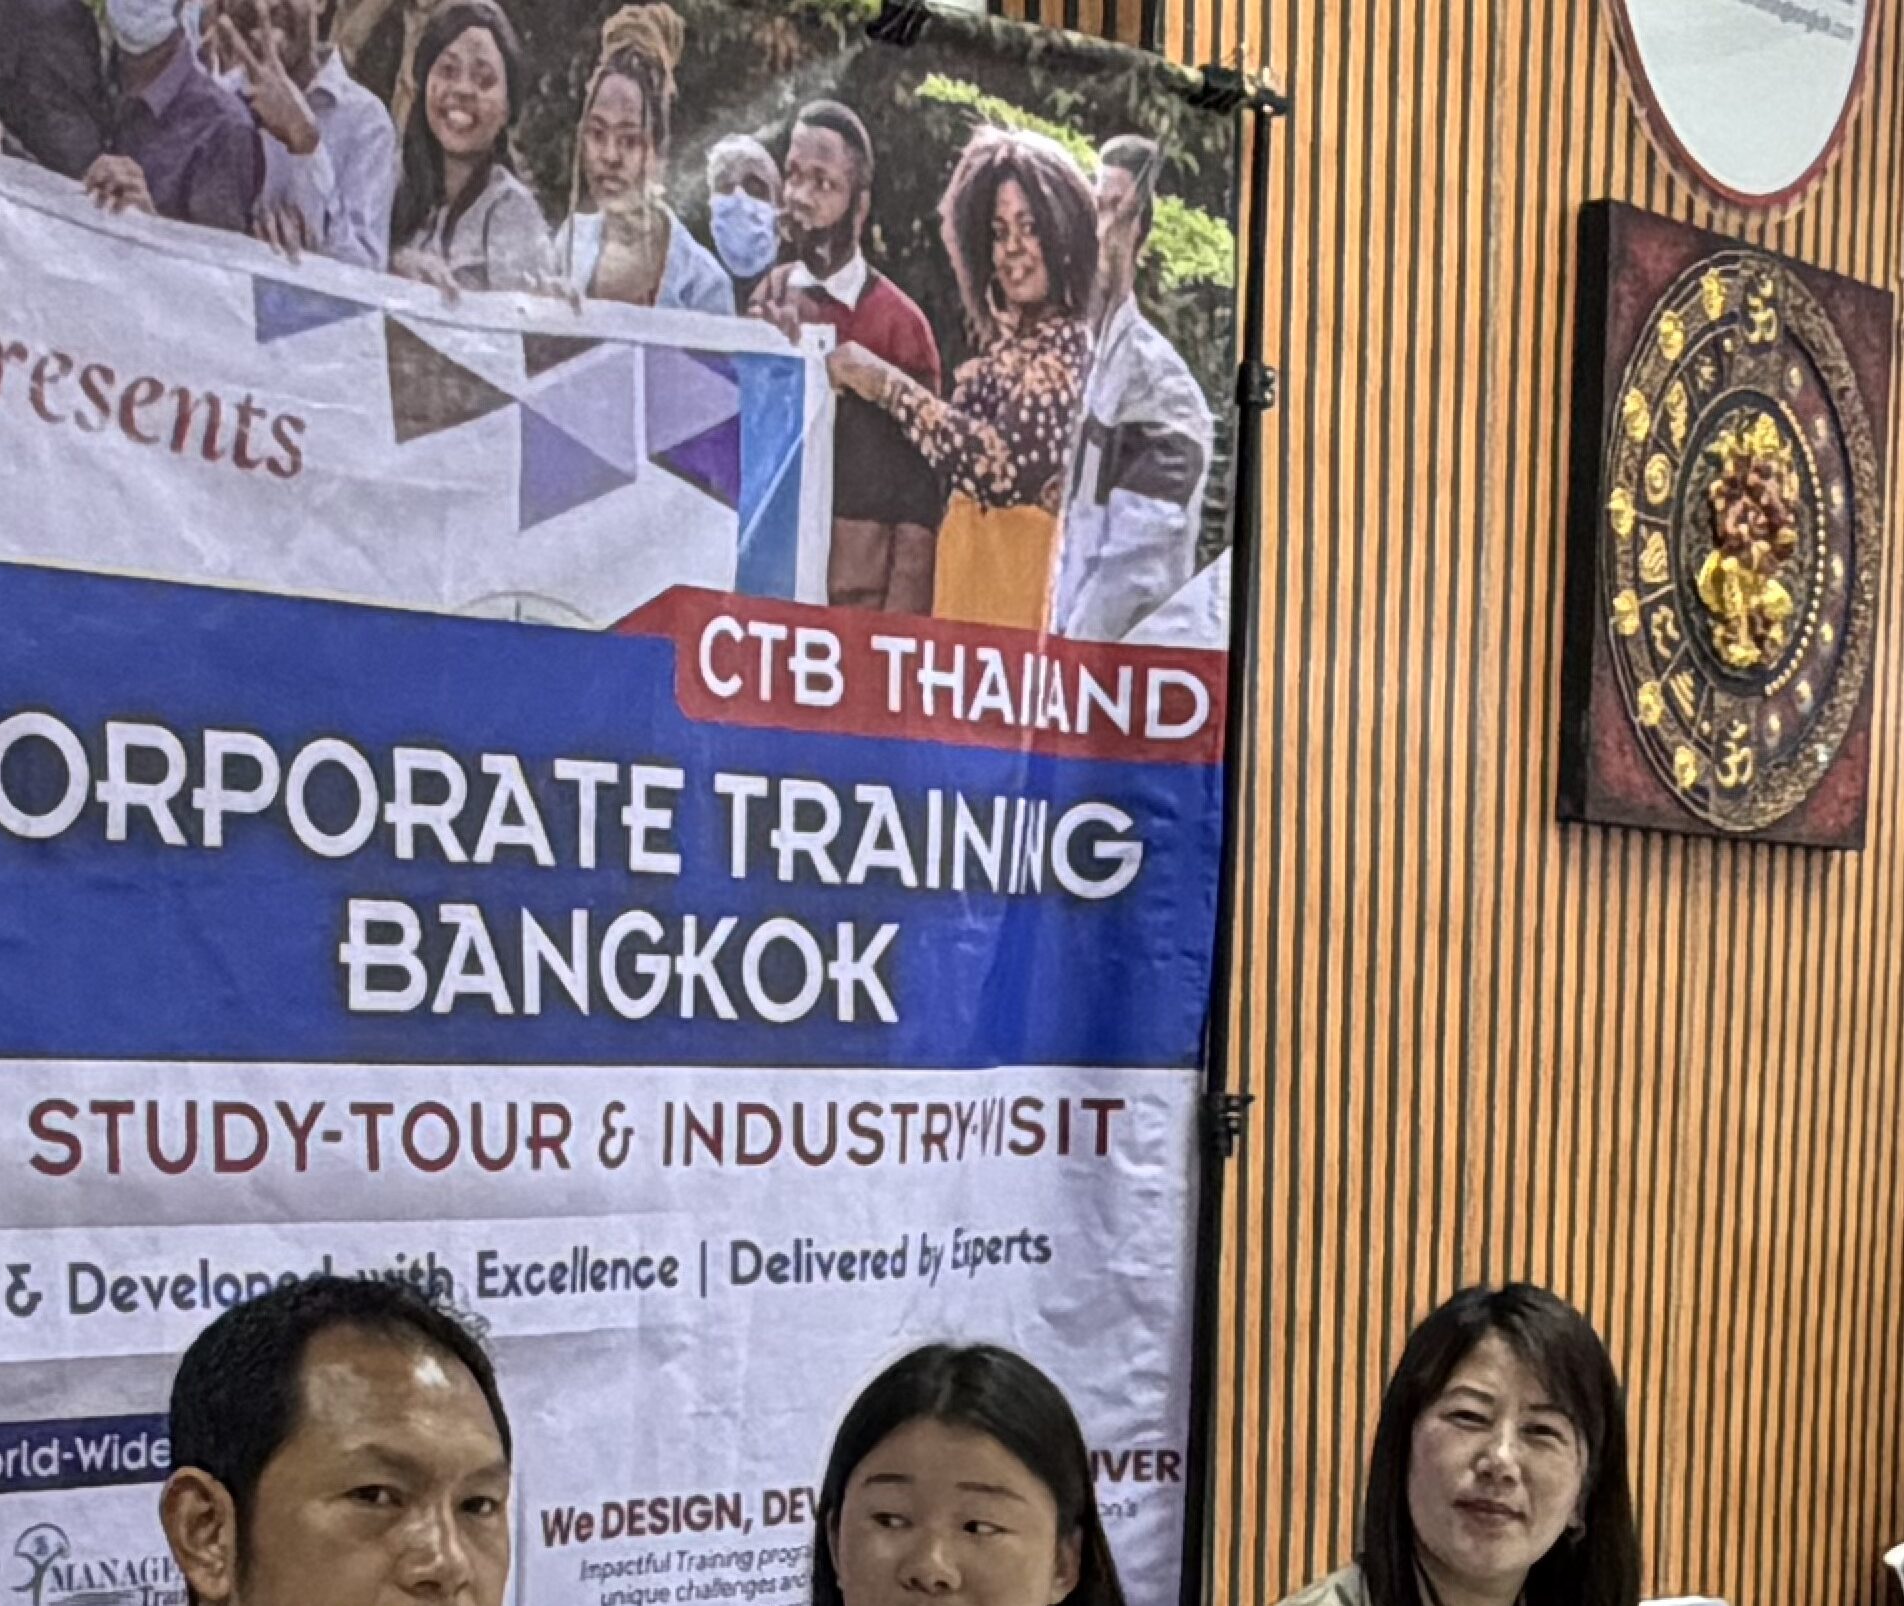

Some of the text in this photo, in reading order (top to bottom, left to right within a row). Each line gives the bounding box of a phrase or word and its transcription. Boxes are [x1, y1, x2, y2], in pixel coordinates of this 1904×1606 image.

[698, 614, 1210, 739] CTB THAILAND
[713, 772, 1144, 900] TRAINING
[337, 897, 898, 1024] BANGKOK
[28, 1097, 572, 1176] STUDY-TOUR
[597, 1100, 633, 1168] &
[4, 1264, 43, 1315] &
[476, 1243, 679, 1301] Excellence
[729, 1232, 909, 1289] Delivered
[918, 1233, 945, 1288] by
[950, 1227, 1052, 1279] Experts
[1090, 1450, 1182, 1484] IVER
[541, 1487, 818, 1549] We DESIGN, DEV
[47, 1555, 182, 1594] MANAGE
[580, 1551, 672, 1582] Impactful
[677, 1548, 753, 1573] Training
[675, 1575, 776, 1602] challenges
